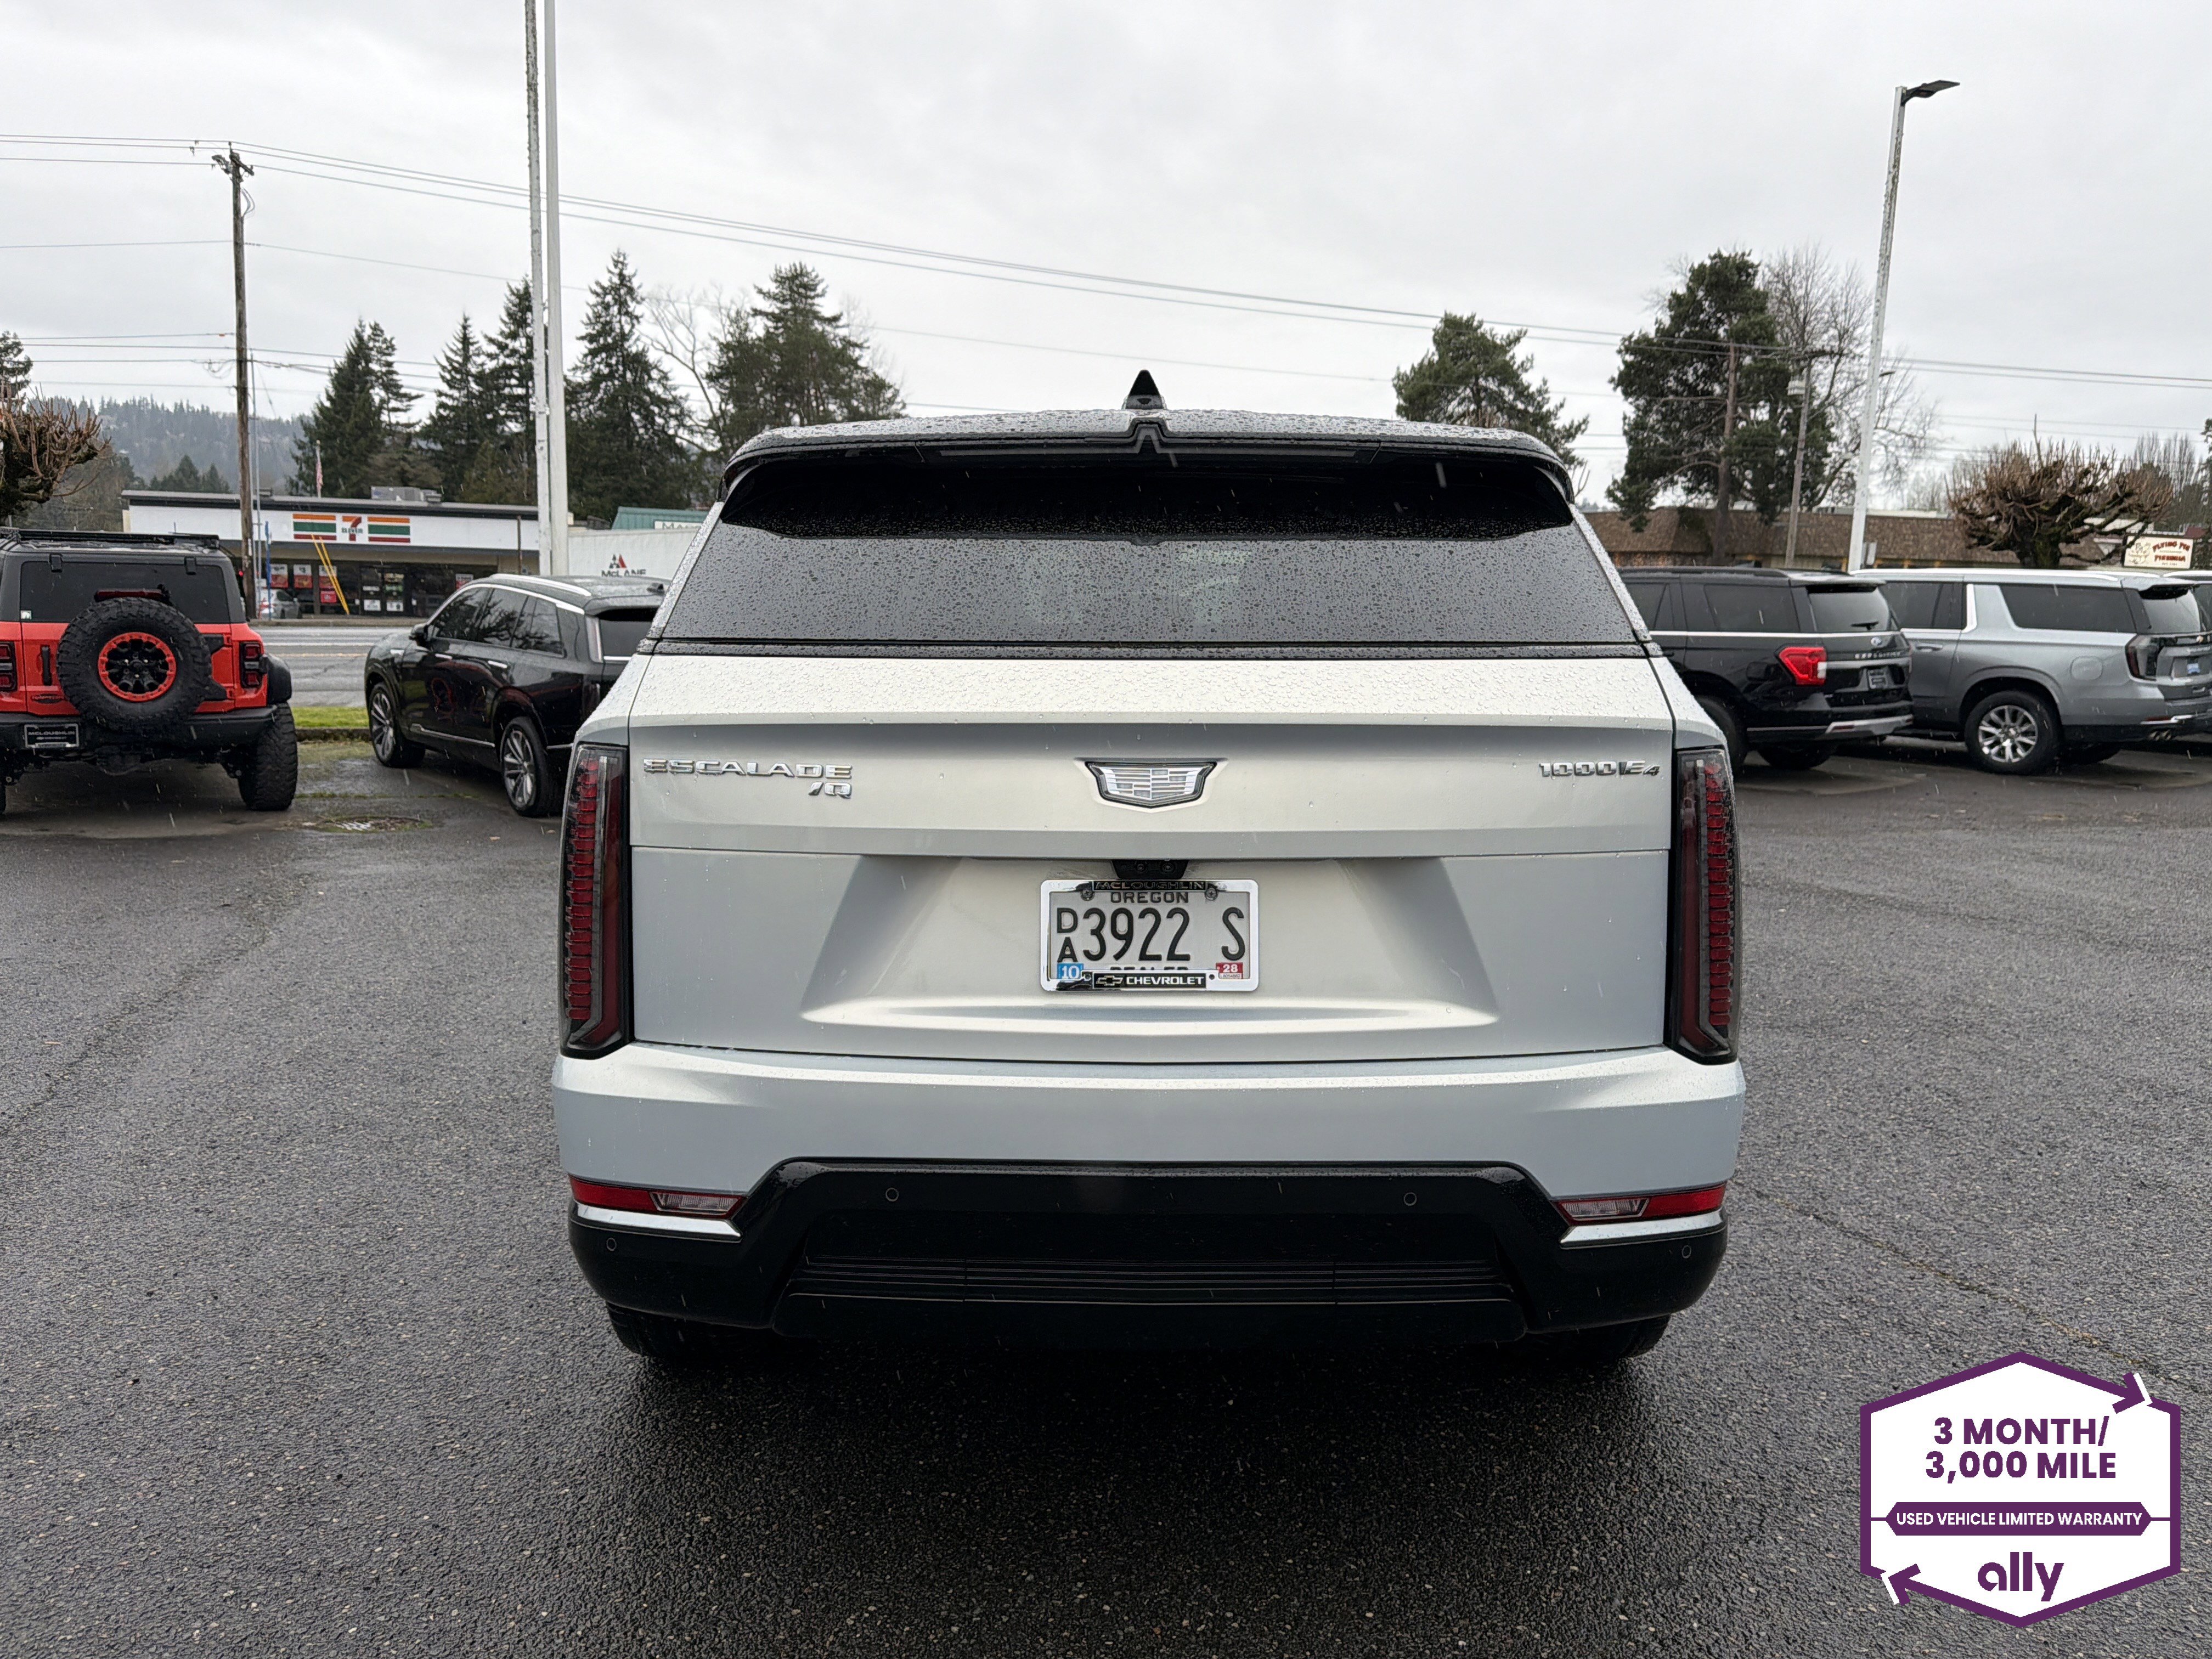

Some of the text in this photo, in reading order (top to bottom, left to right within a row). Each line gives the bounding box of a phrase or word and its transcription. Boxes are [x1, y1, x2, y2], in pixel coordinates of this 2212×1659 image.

[342, 516, 362, 541] 7
[644, 758, 853, 779] ESCALADE
[1110, 891, 1189, 904] OREGON
[1082, 907, 1191, 962] 3922
[1221, 907, 1246, 961] S
[1061, 966, 1080, 979] 10
[1223, 964, 1238, 973] 28
[1126, 977, 1205, 985] CHEVROLET
